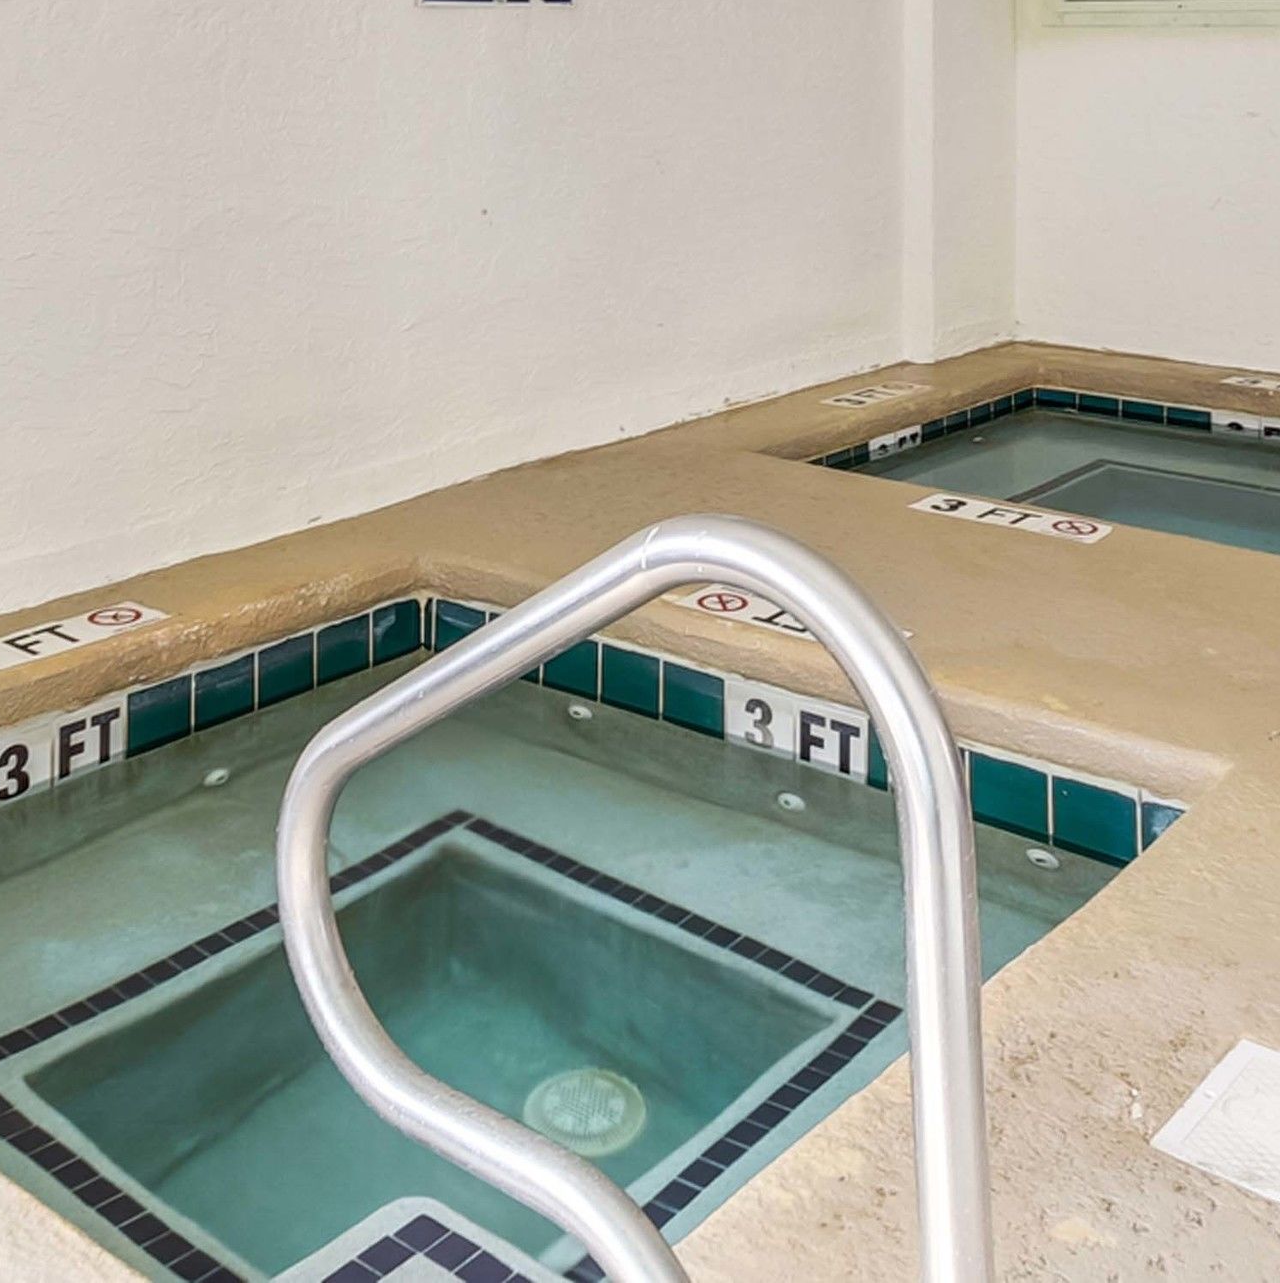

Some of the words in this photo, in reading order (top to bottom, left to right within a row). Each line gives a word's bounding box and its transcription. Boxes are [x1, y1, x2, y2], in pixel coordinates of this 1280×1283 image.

[931, 498, 967, 512] 3
[977, 507, 1043, 525] FT
[4, 624, 80, 656] FT
[58, 706, 120, 781] FT
[745, 698, 773, 748] 3
[800, 710, 860, 774] FT
